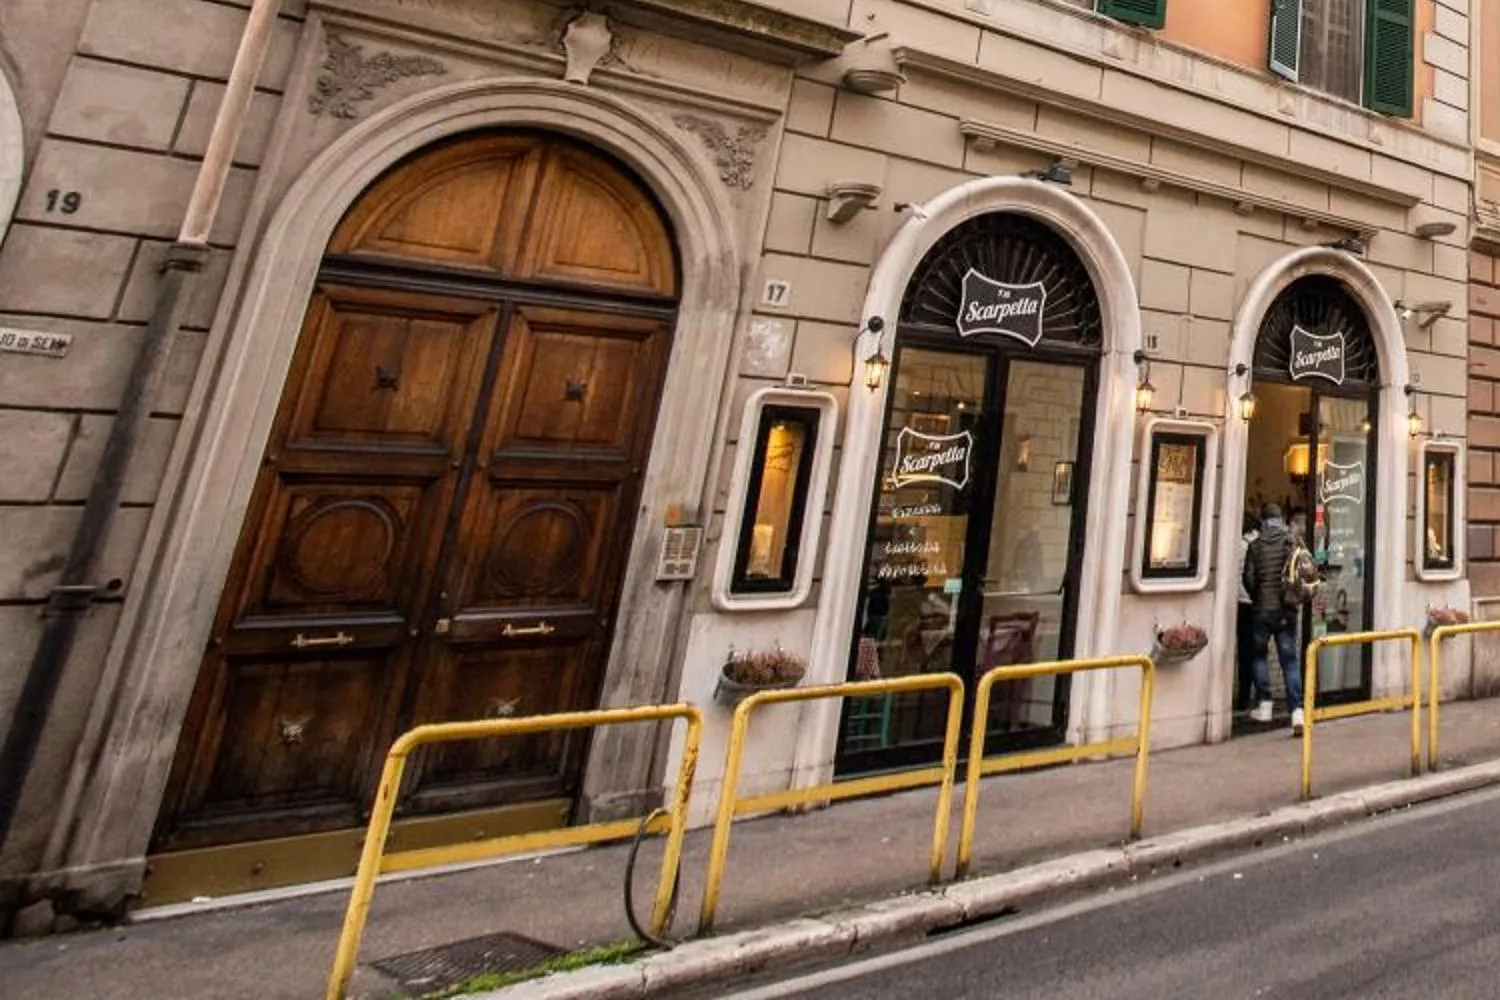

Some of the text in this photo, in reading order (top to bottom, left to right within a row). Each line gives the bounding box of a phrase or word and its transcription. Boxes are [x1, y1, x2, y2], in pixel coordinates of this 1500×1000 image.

[46, 188, 82, 215] 19
[767, 284, 787, 302] 17
[965, 297, 1038, 324] Scarpetta
[1295, 345, 1340, 368] Scarpetta
[900, 446, 965, 473] Scarpetta
